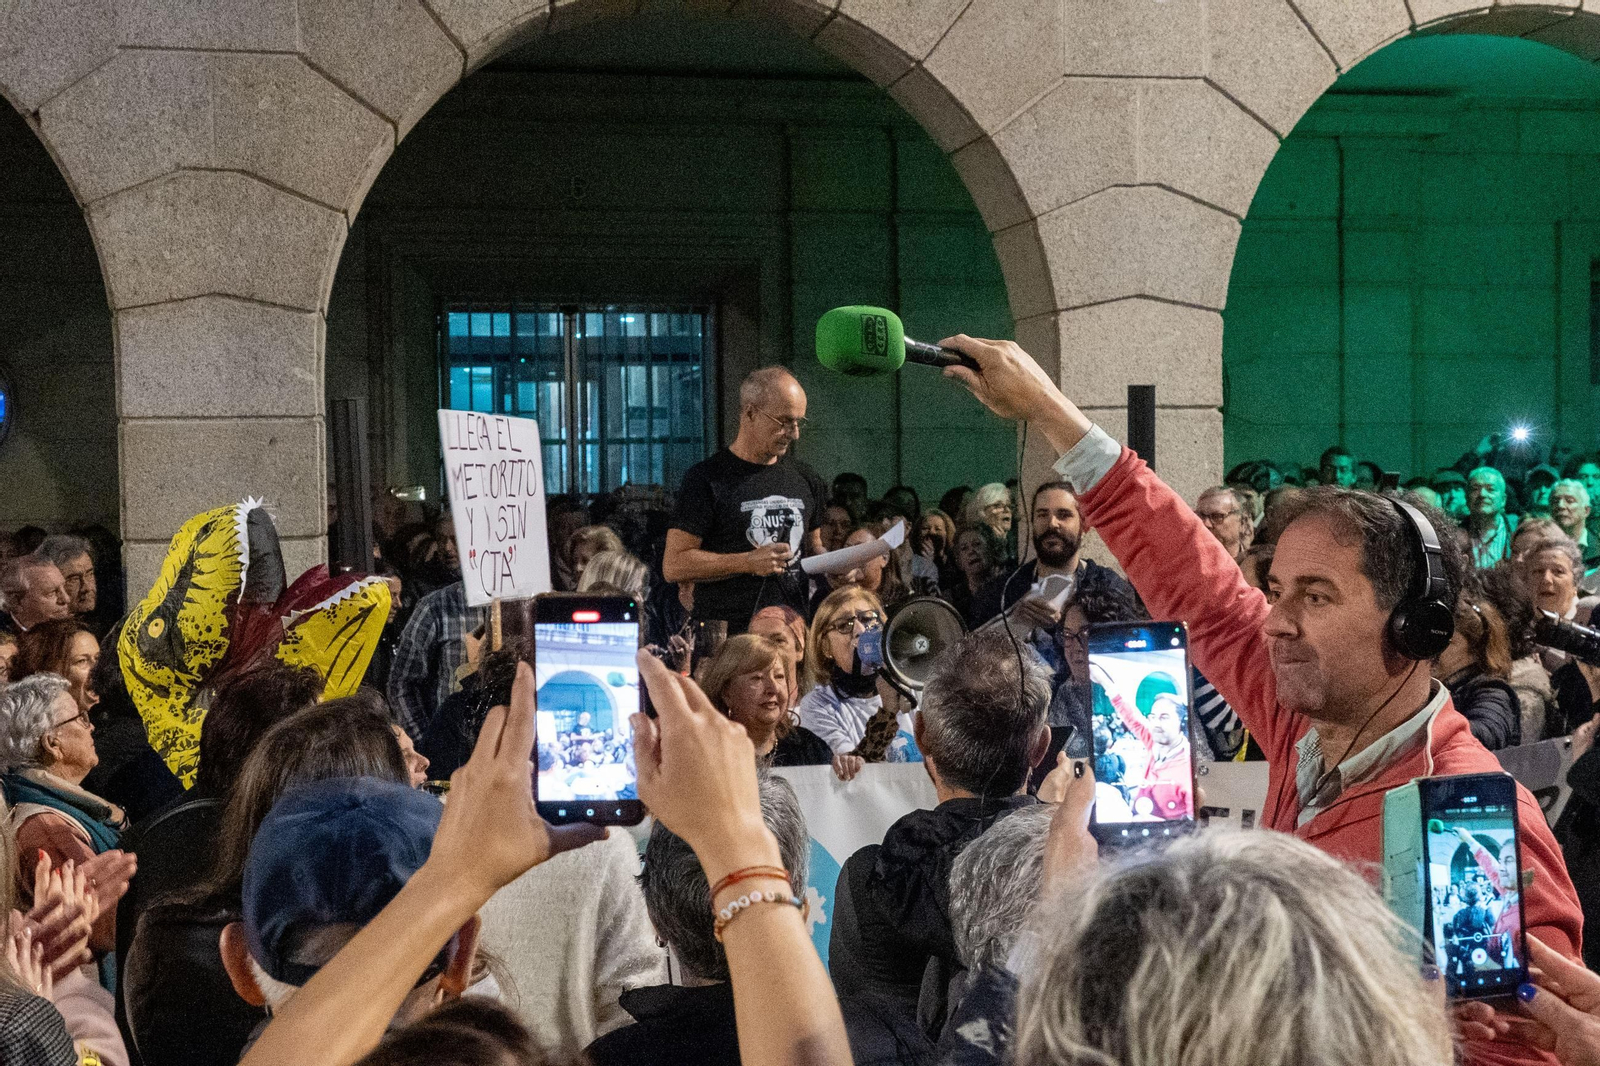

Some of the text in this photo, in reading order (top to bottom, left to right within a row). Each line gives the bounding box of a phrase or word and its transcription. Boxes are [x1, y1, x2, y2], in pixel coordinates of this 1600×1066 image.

[495, 417, 522, 453] EL
[495, 501, 527, 543] SIN
[1430, 628, 1448, 636] SONY
